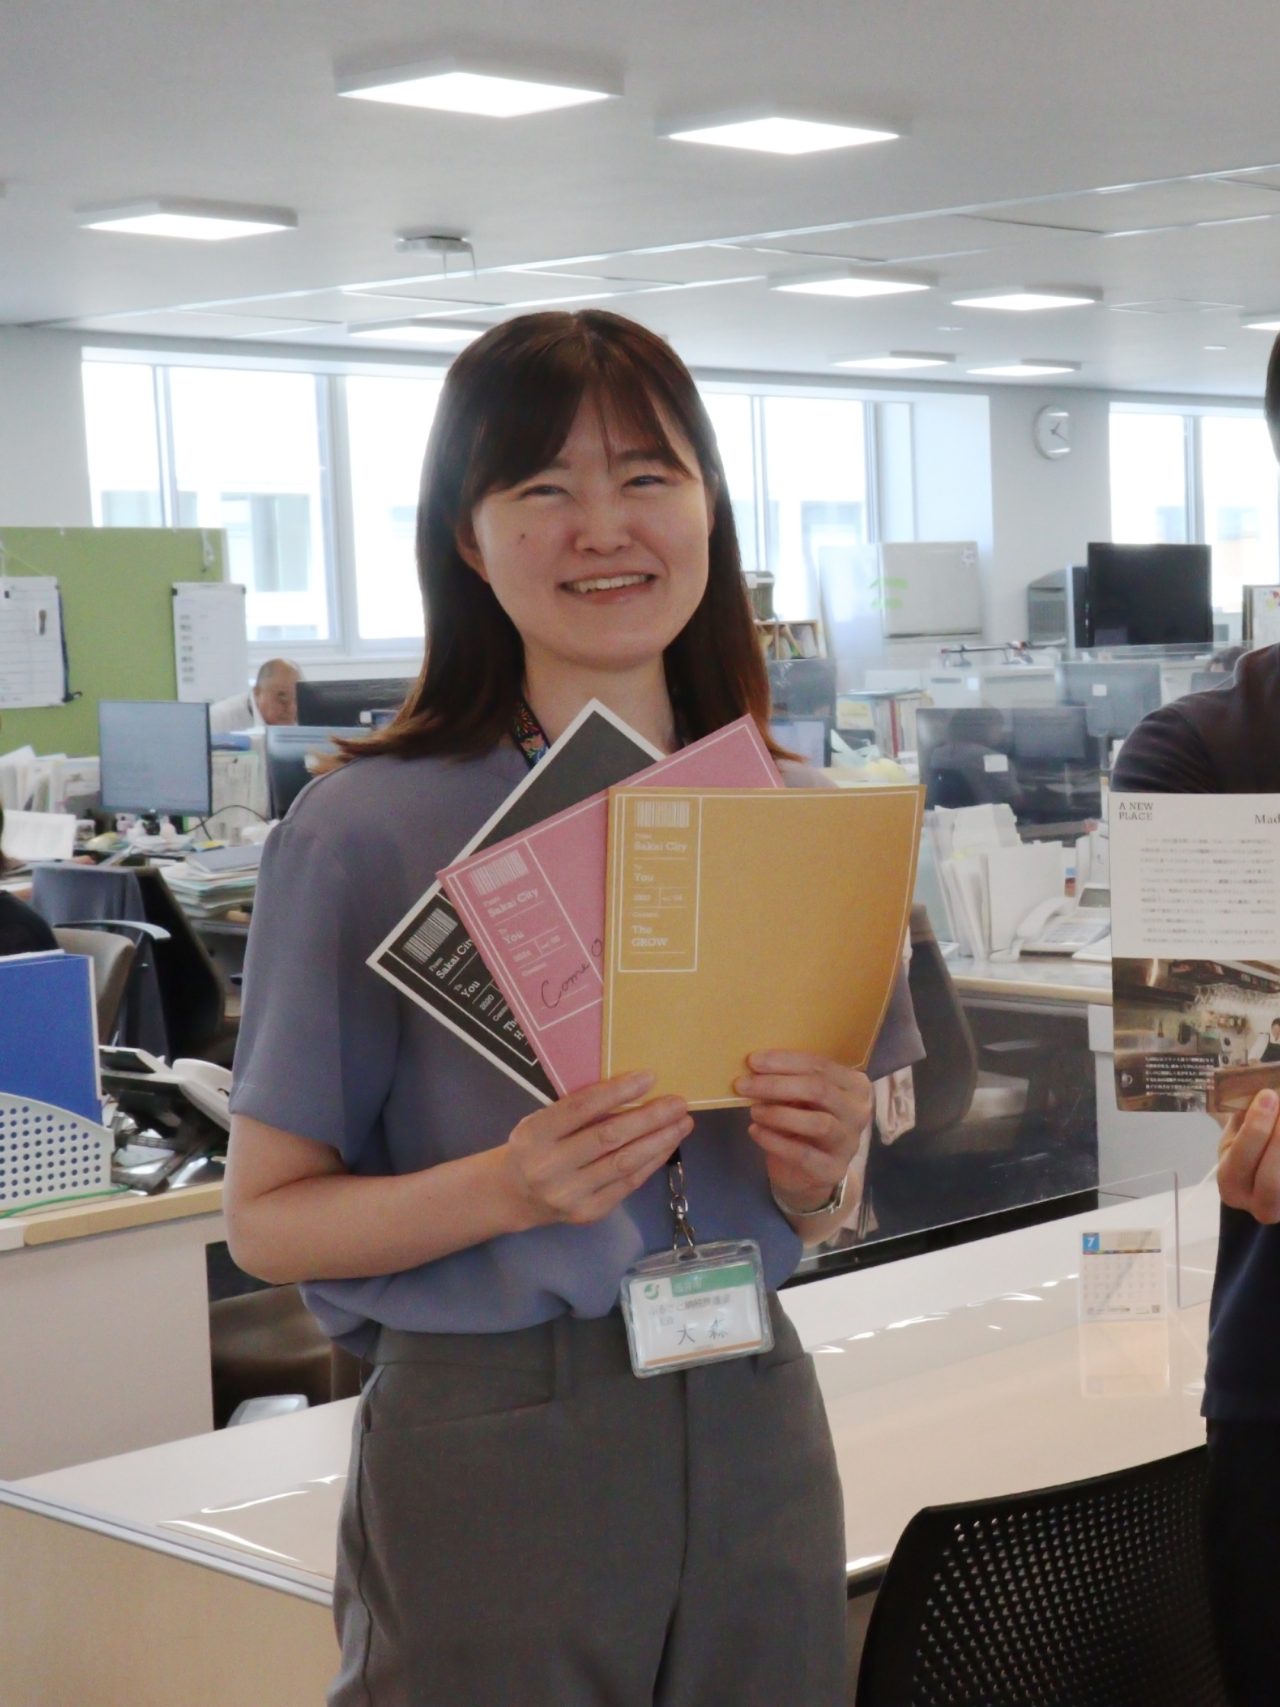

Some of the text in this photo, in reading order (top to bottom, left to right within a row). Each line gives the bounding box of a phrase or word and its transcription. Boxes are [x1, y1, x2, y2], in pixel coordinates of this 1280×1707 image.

[1119, 801, 1154, 811] A NEW
[1119, 811, 1153, 821] PLACE
[634, 841, 688, 853] Sakai City
[634, 873, 655, 883] You
[487, 887, 539, 918] Sakai City
[632, 924, 653, 935] The
[503, 930, 525, 945] You
[631, 937, 668, 947] GROW
[435, 954, 460, 980] Sakai
[461, 980, 481, 998] You
[541, 961, 591, 1009] Come
[503, 1017, 518, 1032] Th
[1086, 1236, 1096, 1248] 7
